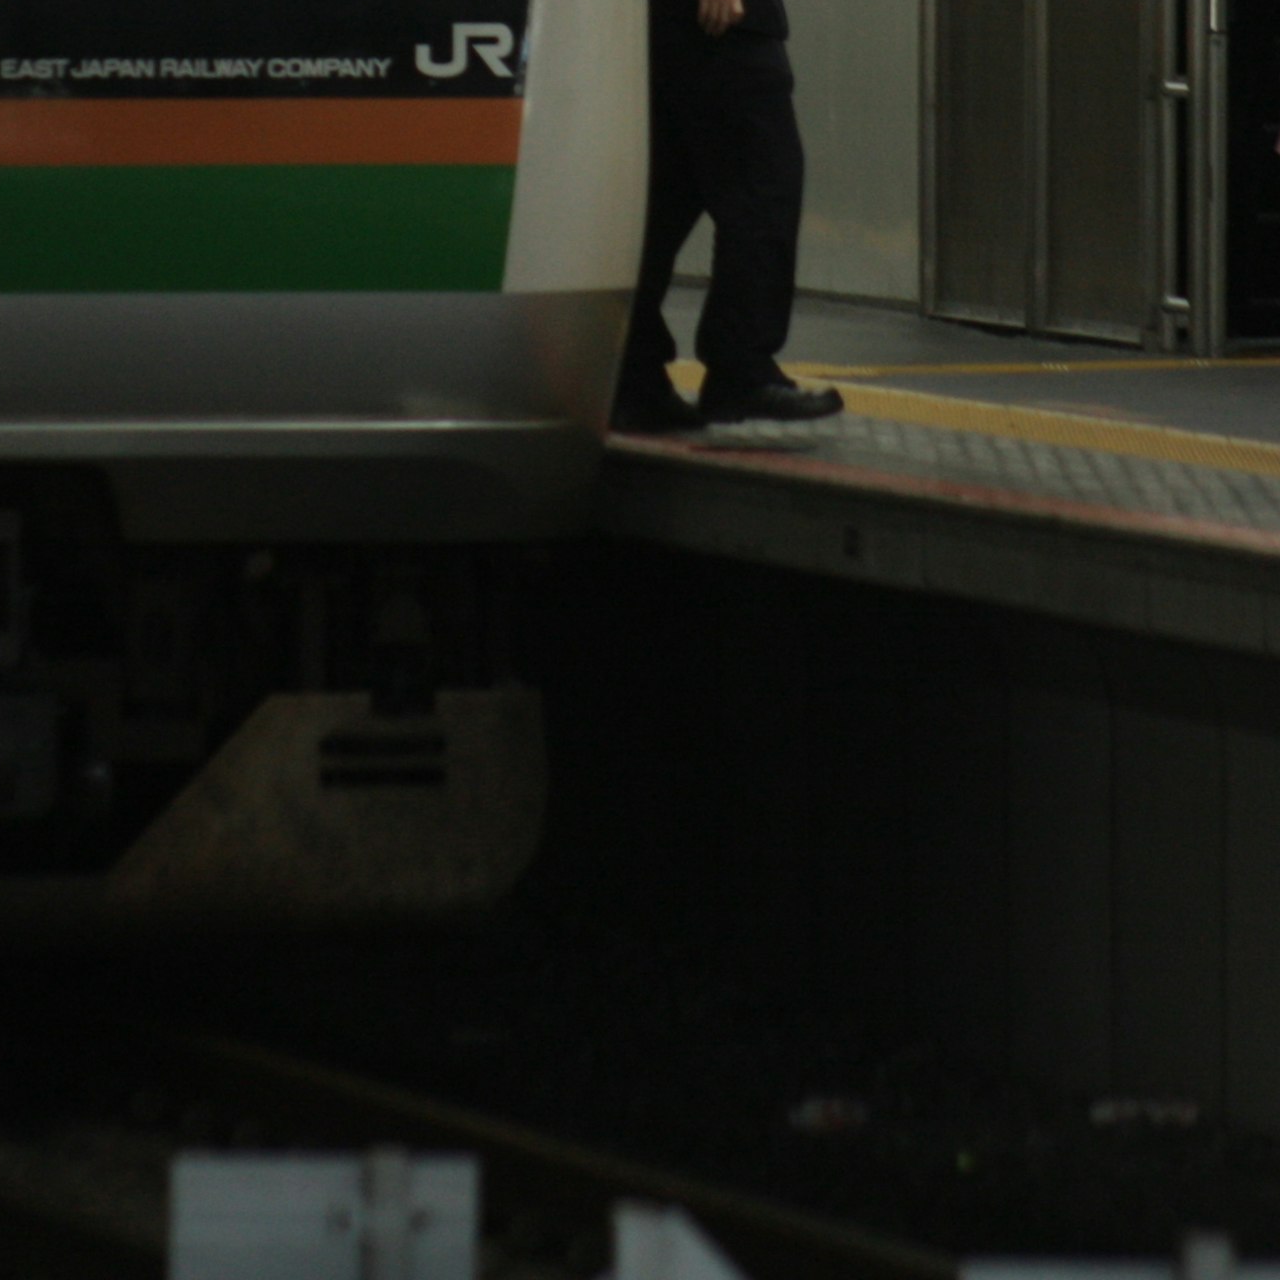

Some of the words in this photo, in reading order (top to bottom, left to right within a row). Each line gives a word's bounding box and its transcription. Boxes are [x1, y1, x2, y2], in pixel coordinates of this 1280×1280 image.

[0, 57, 68, 79] EAST
[71, 57, 156, 79] JAPAN
[160, 57, 264, 79] RAILWAY
[267, 57, 392, 79] COMPANY
[414, 22, 514, 78] JR
